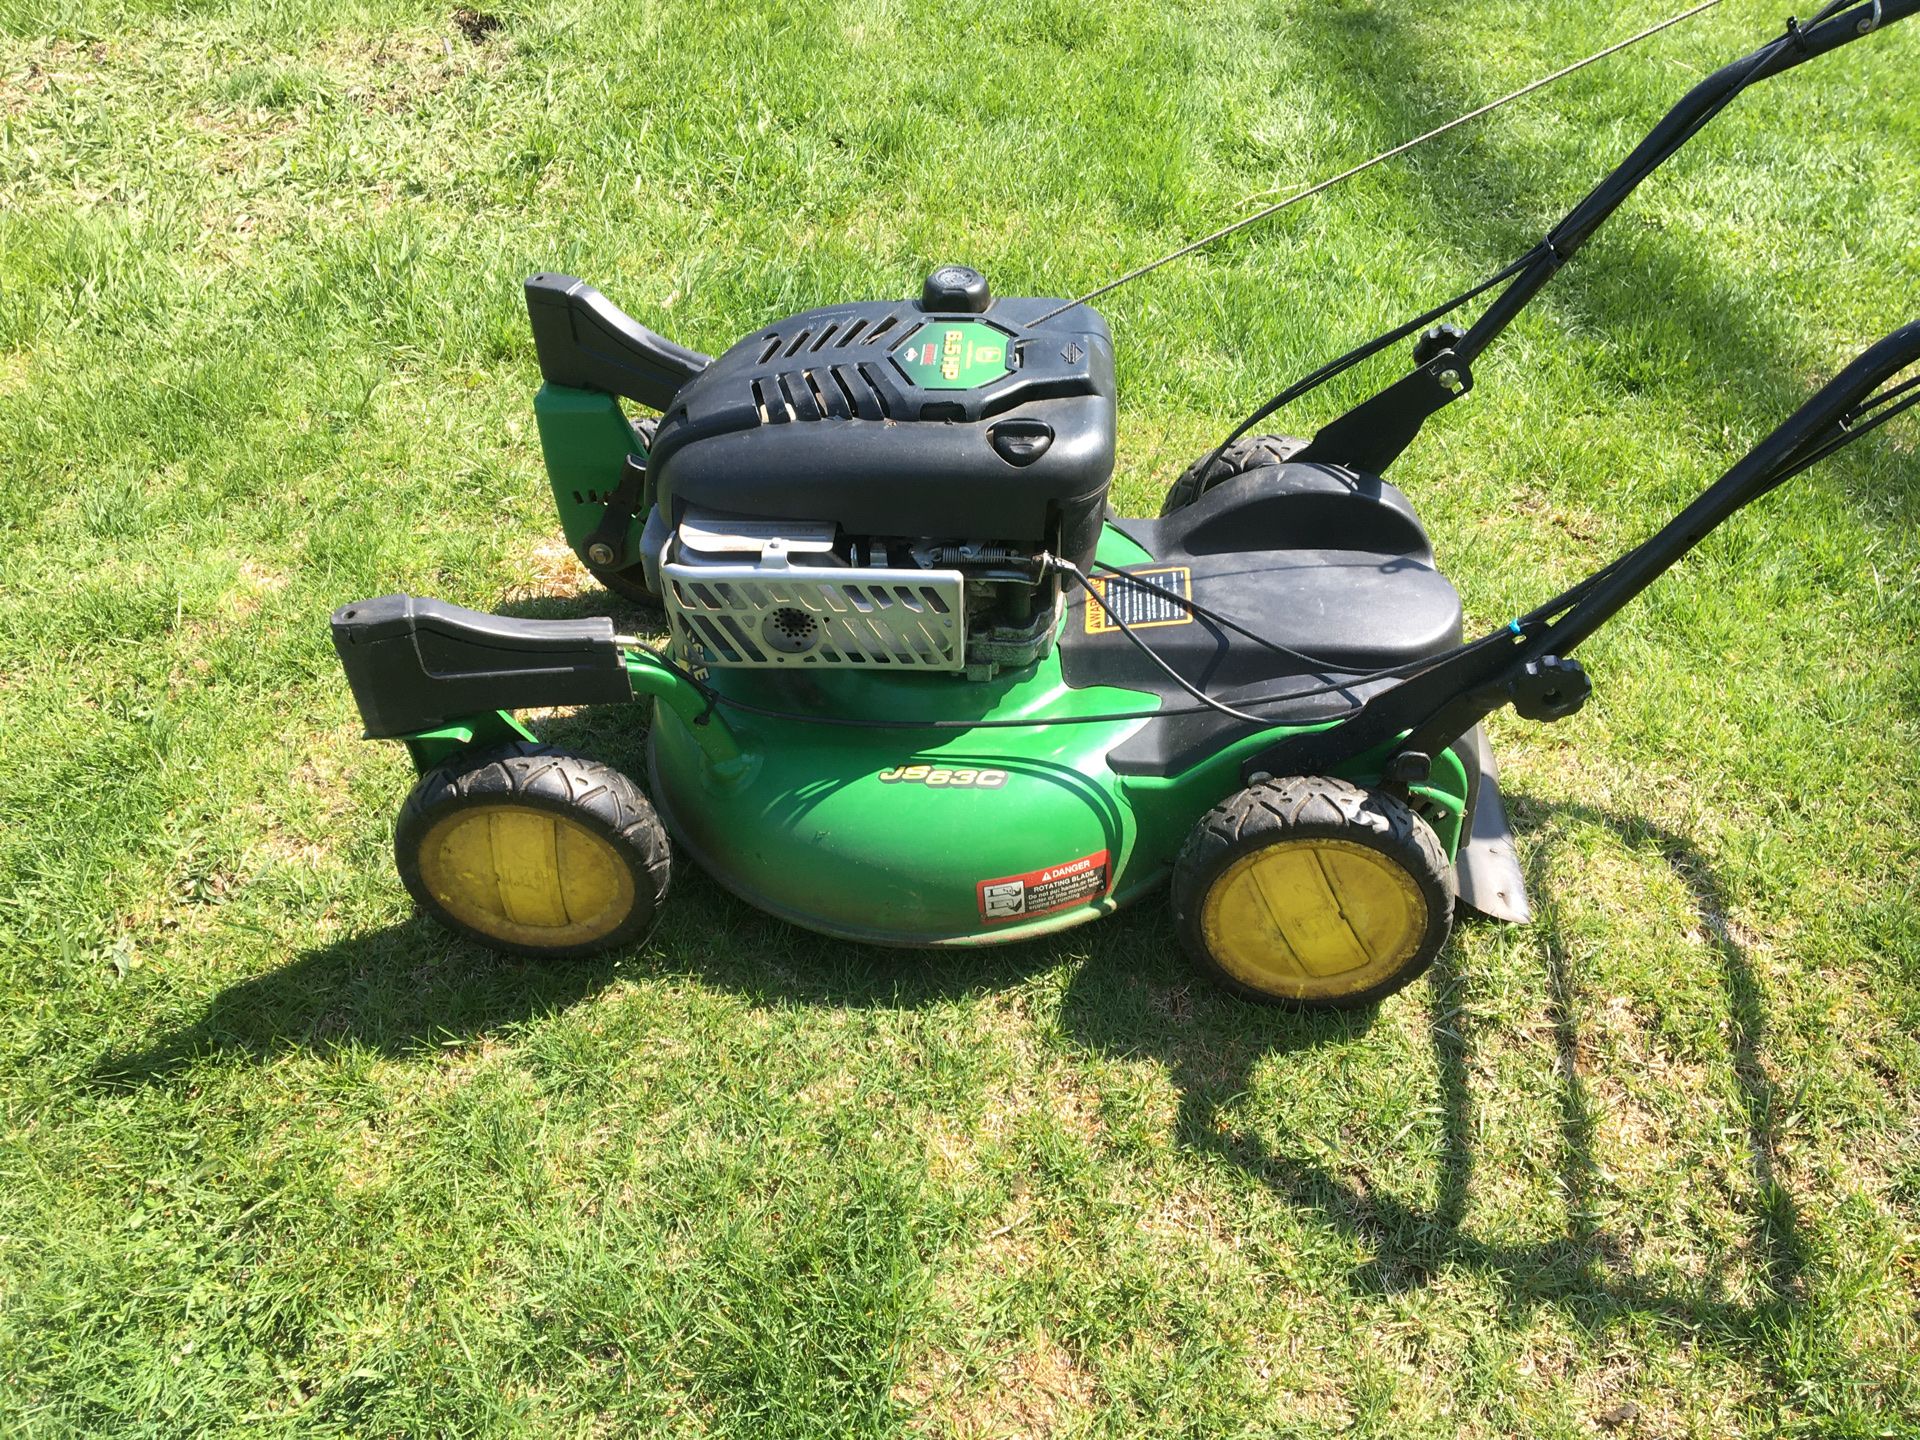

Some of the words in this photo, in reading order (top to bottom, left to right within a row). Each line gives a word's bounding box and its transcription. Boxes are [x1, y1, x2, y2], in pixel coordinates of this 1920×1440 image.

[942, 356, 961, 380] HP
[1090, 579, 1101, 622] WARNG
[879, 765, 1007, 788] JS63C
[1052, 860, 1090, 878] DANGER
[1033, 878, 1070, 893] ROTATING
[1071, 870, 1095, 883] BLADE
[1049, 888, 1060, 896] put
[1060, 882, 1079, 892] hands
[1087, 875, 1098, 883] feet
[1028, 897, 1047, 905] under
[1055, 891, 1067, 899] into
[1068, 884, 1087, 895] mower
